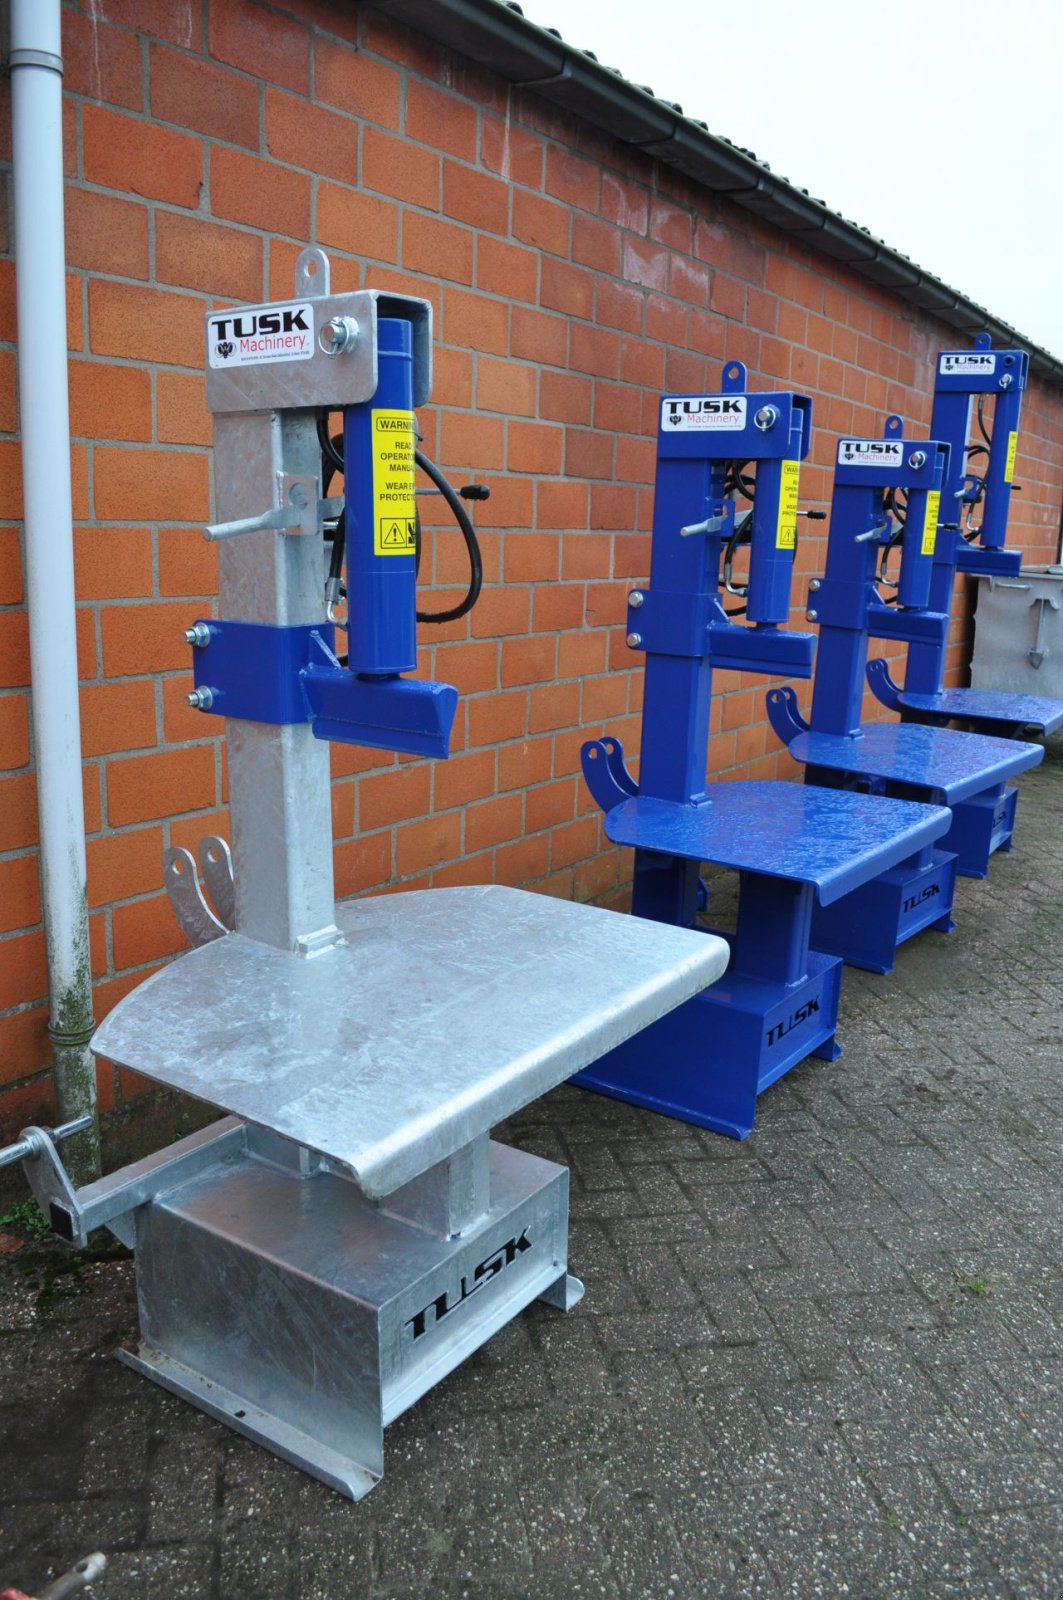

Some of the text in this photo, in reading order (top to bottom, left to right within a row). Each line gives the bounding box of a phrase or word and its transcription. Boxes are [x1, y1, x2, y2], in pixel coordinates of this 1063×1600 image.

[211, 309, 310, 341] TUSK
[240, 334, 306, 353] Machinery
[941, 356, 993, 365] TUSK
[665, 399, 743, 414] TUSK
[687, 414, 740, 424] Machinery
[842, 442, 900, 454] TUSK
[858, 452, 898, 462] Machinery
[903, 883, 940, 913] TUSK
[765, 995, 820, 1047] TUSK
[404, 1226, 533, 1342] TUSK
